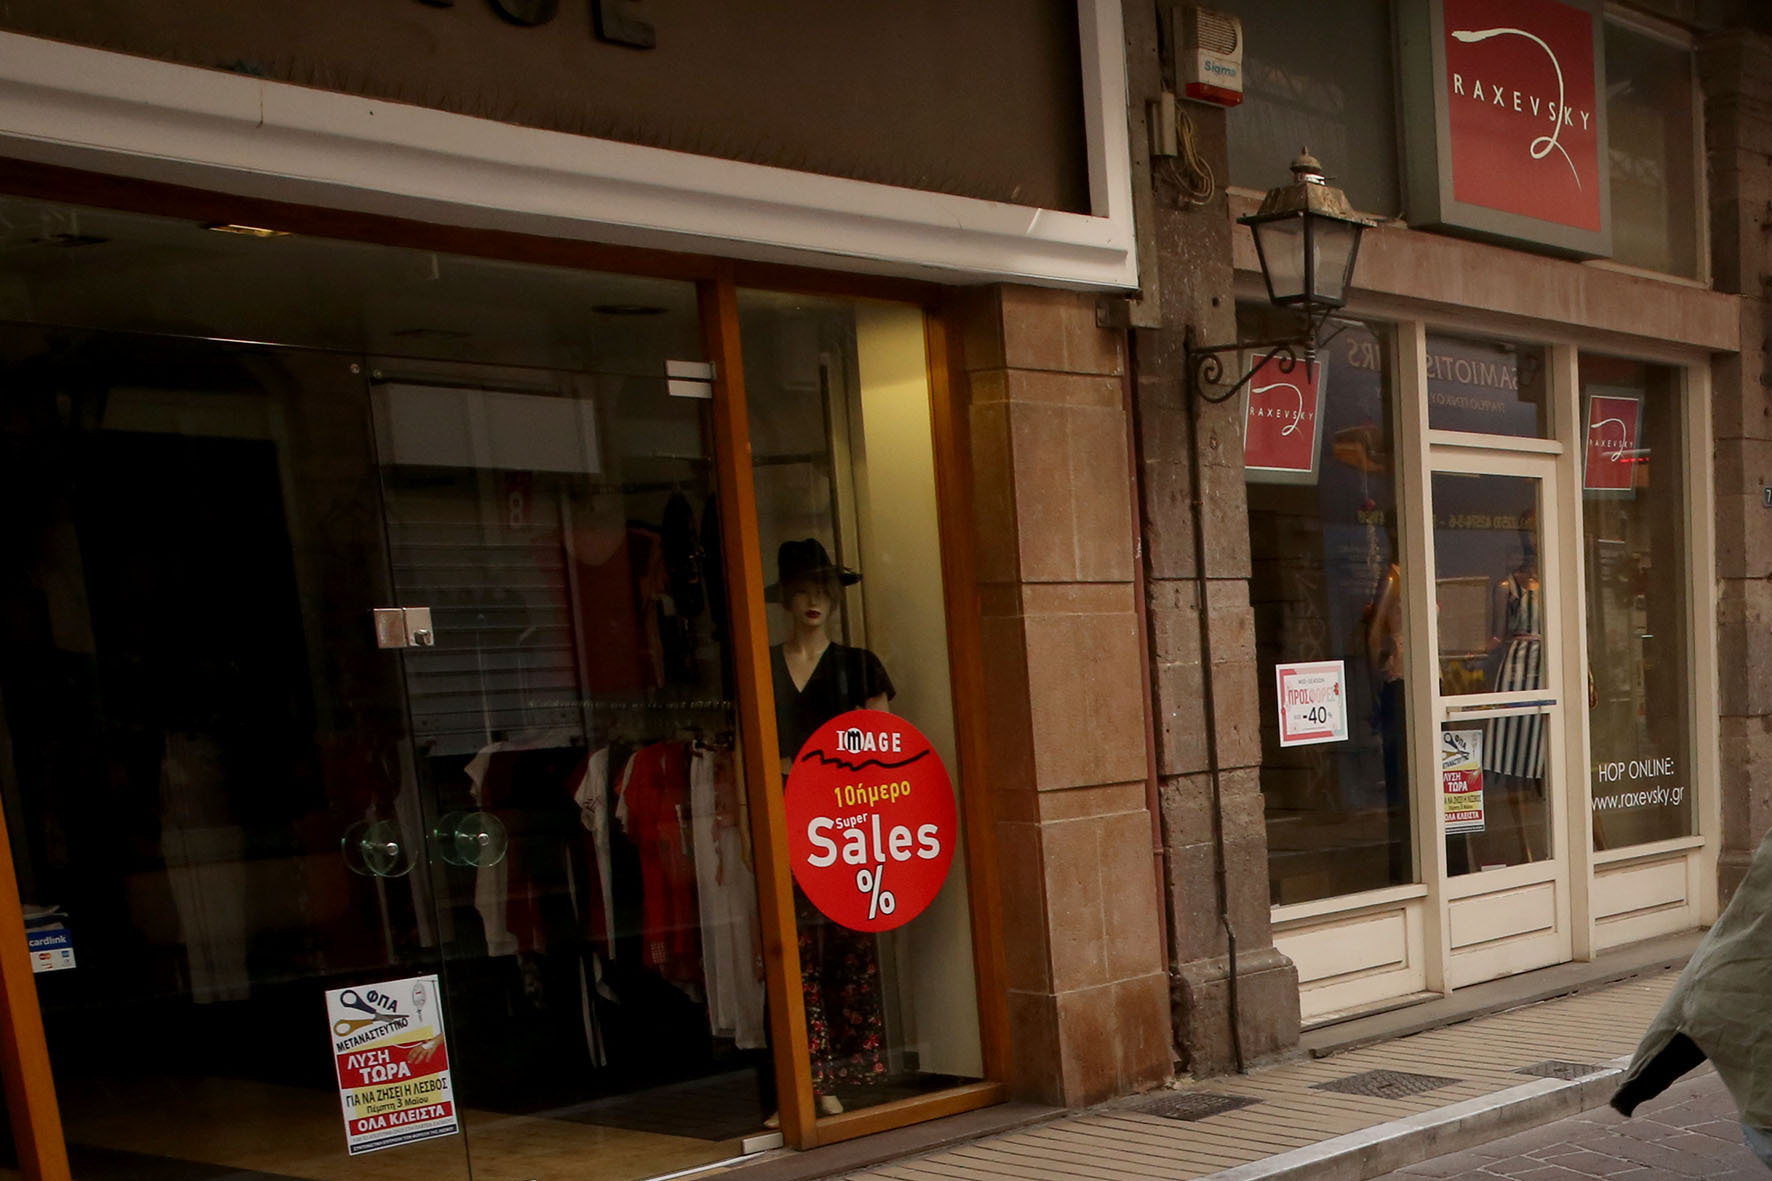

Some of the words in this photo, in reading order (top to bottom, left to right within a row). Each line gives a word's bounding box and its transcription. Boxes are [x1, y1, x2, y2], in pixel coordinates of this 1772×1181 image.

[1204, 60, 1237, 77] Sigma
[1453, 72, 1591, 131] RAXEVSKY
[1249, 407, 1314, 421] RAXEVSKY
[1589, 439, 1634, 448] RAXEVSKY
[834, 780, 911, 808] 10ήμερο
[1448, 781, 1468, 793] ΤΩΡΑ
[836, 813, 868, 830] Super
[807, 814, 941, 868] Sales
[856, 864, 896, 920] %
[28, 935, 67, 947] cardlink
[366, 989, 400, 1013] ΦΠΑ
[336, 1017, 410, 1053] ΜΕΤΑΝΑΣΤΕΥΤΙΚΟ
[347, 1048, 391, 1070] ΛΥΣΗ
[359, 1060, 411, 1085] ΤΩΡΑ
[346, 1094, 360, 1108] ΓΙΑ
[361, 1092, 376, 1104] ΝΑ
[377, 1086, 404, 1102] ΖΗΣΕΙ
[405, 1085, 411, 1096] Η
[412, 1077, 448, 1095] ΛΕΣΒΟΣ
[357, 1116, 387, 1132] ΟΛΑ
[390, 1104, 446, 1126] ΚΛΕΙΣΤΑ
[366, 1101, 396, 1115] Πέμπτη
[397, 1098, 403, 1108] 3
